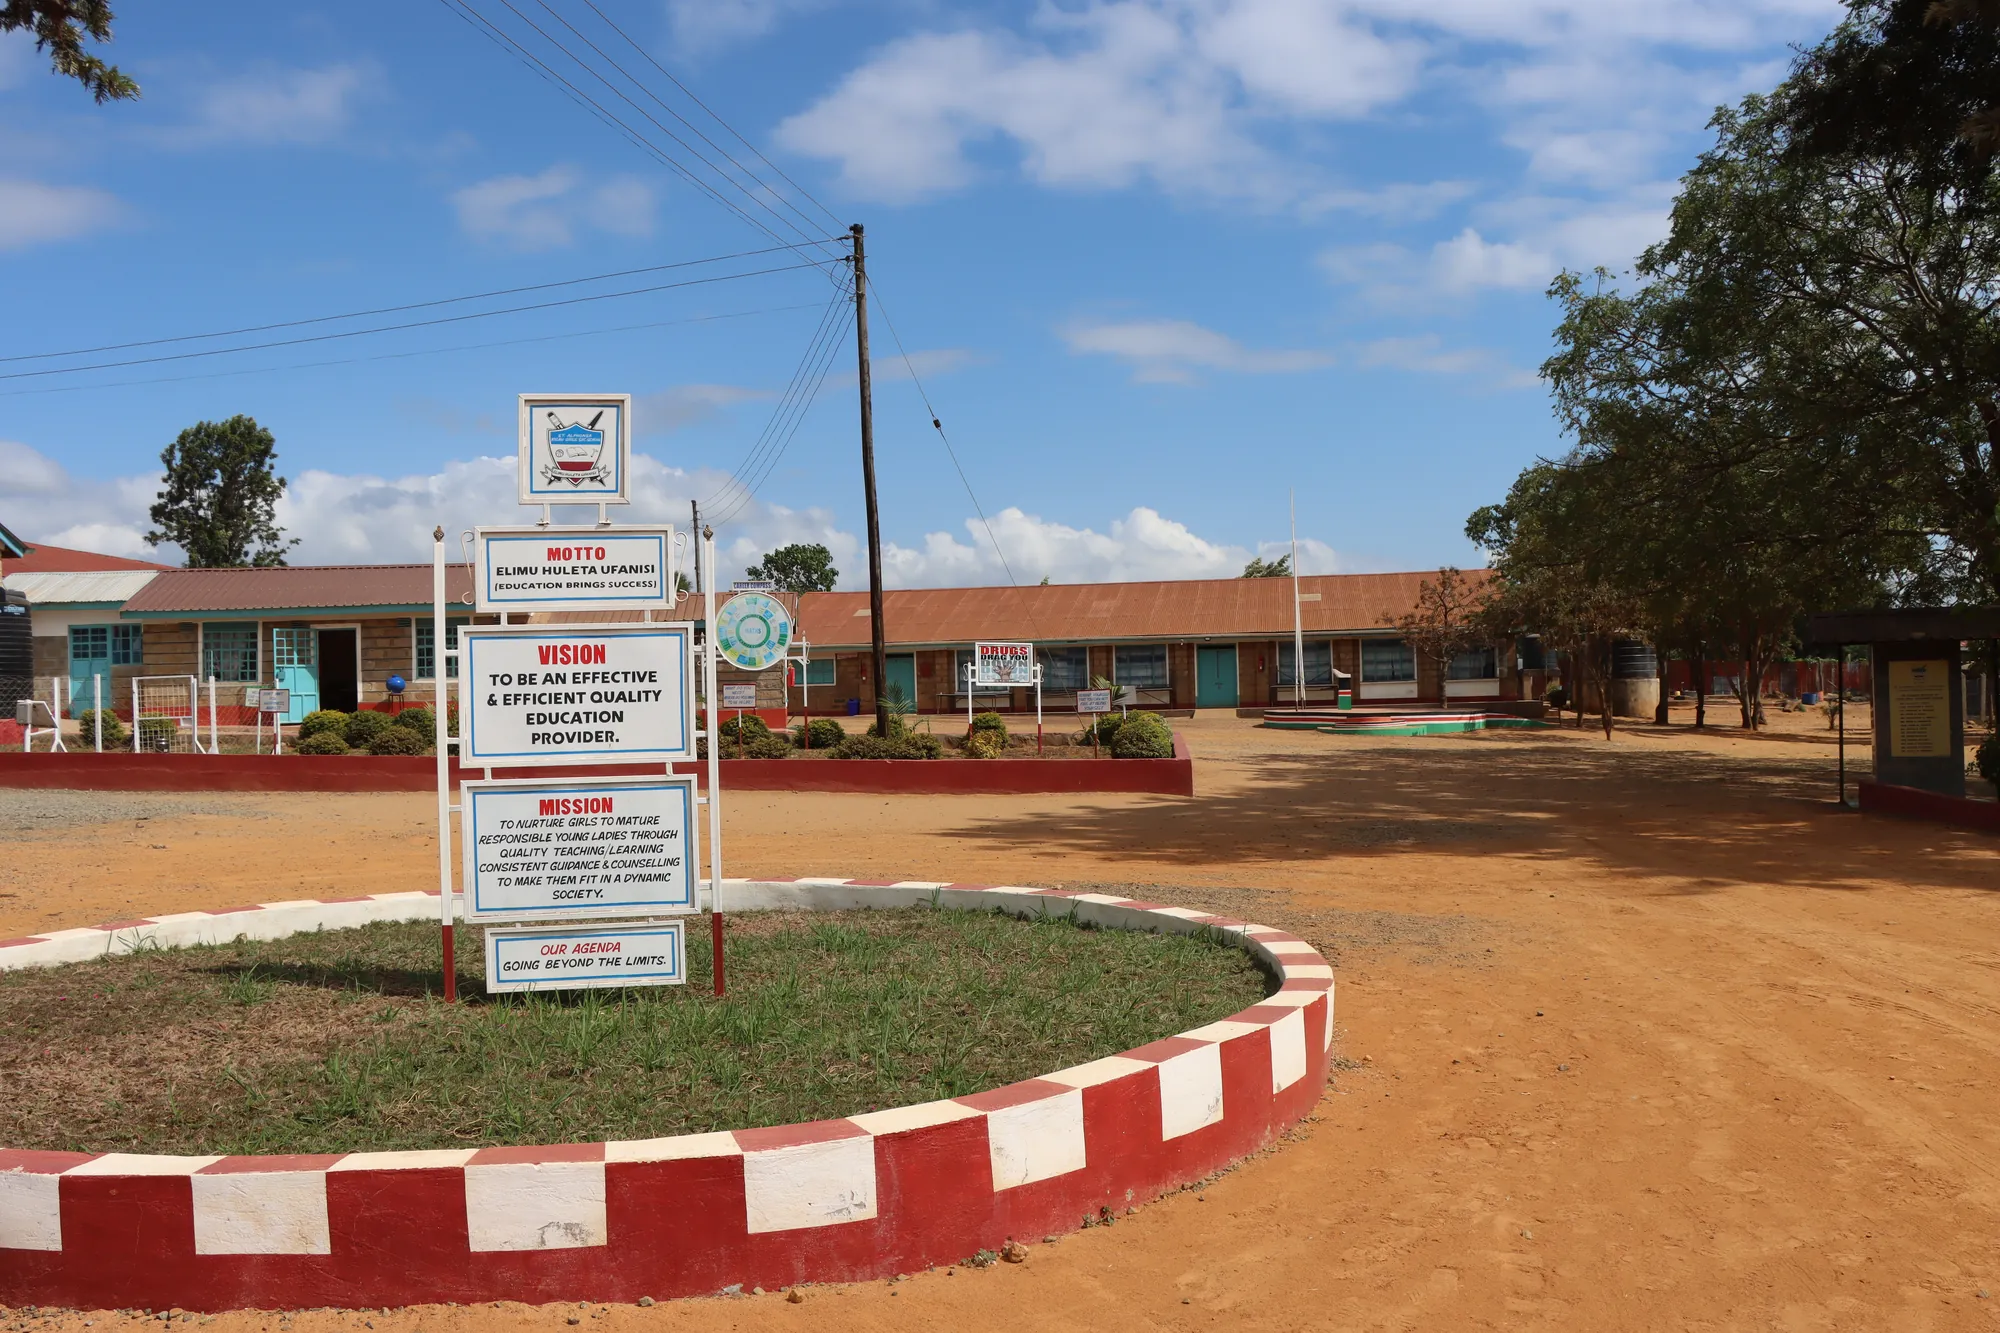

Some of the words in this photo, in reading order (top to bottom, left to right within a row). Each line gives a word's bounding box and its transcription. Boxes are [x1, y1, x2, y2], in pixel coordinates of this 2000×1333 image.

[548, 547, 605, 561] MOTTO
[497, 567, 538, 576] ELIMU
[543, 566, 597, 575] HULETA
[601, 565, 654, 574] UFANISI
[495, 583, 562, 591] (EDUCATION
[538, 644, 605, 665] VISION
[981, 646, 1028, 655] DRUGS
[489, 674, 512, 686] TO
[518, 673, 537, 685] BE
[542, 673, 566, 685] AN
[573, 671, 657, 684] EFFECTIVE
[487, 694, 497, 706] &
[503, 692, 586, 705] EFFICIENT
[590, 690, 662, 703] QUALITY
[526, 711, 623, 725] EDUCATION
[532, 731, 619, 744] PROVIDER.
[540, 797, 612, 816] MISSION
[500, 820, 514, 829] TO
[516, 818, 565, 828] NURTURE
[569, 817, 597, 827] GIRLS
[601, 817, 614, 825] TO
[616, 816, 660, 825] MATURE
[479, 833, 552, 844] RESPONSIBLE
[556, 832, 590, 841] YOUNG
[592, 831, 627, 841] LADIES
[631, 830, 678, 839] THROUGH
[500, 848, 548, 858] QUALITY
[554, 844, 664, 859] TEACHING/LEARNING
[479, 862, 548, 872] CONSISTENT
[550, 861, 600, 871] GUIDANCE
[602, 861, 609, 869] &
[611, 857, 680, 869] COUNSELLING
[498, 878, 512, 886] TO
[515, 877, 542, 886] MAKE
[546, 876, 576, 885] THEM
[579, 875, 598, 884] FIT
[600, 874, 612, 883] IN
[614, 874, 620, 883] A
[624, 873, 671, 883] DYNAMIC
[553, 889, 603, 899] SOCIETY.
[541, 944, 566, 955] OUR
[572, 942, 620, 954] AGENDA
[503, 960, 540, 971] GOING
[545, 958, 594, 969] BEYOND
[599, 957, 621, 966] THE
[626, 956, 666, 965] LIMITS.
